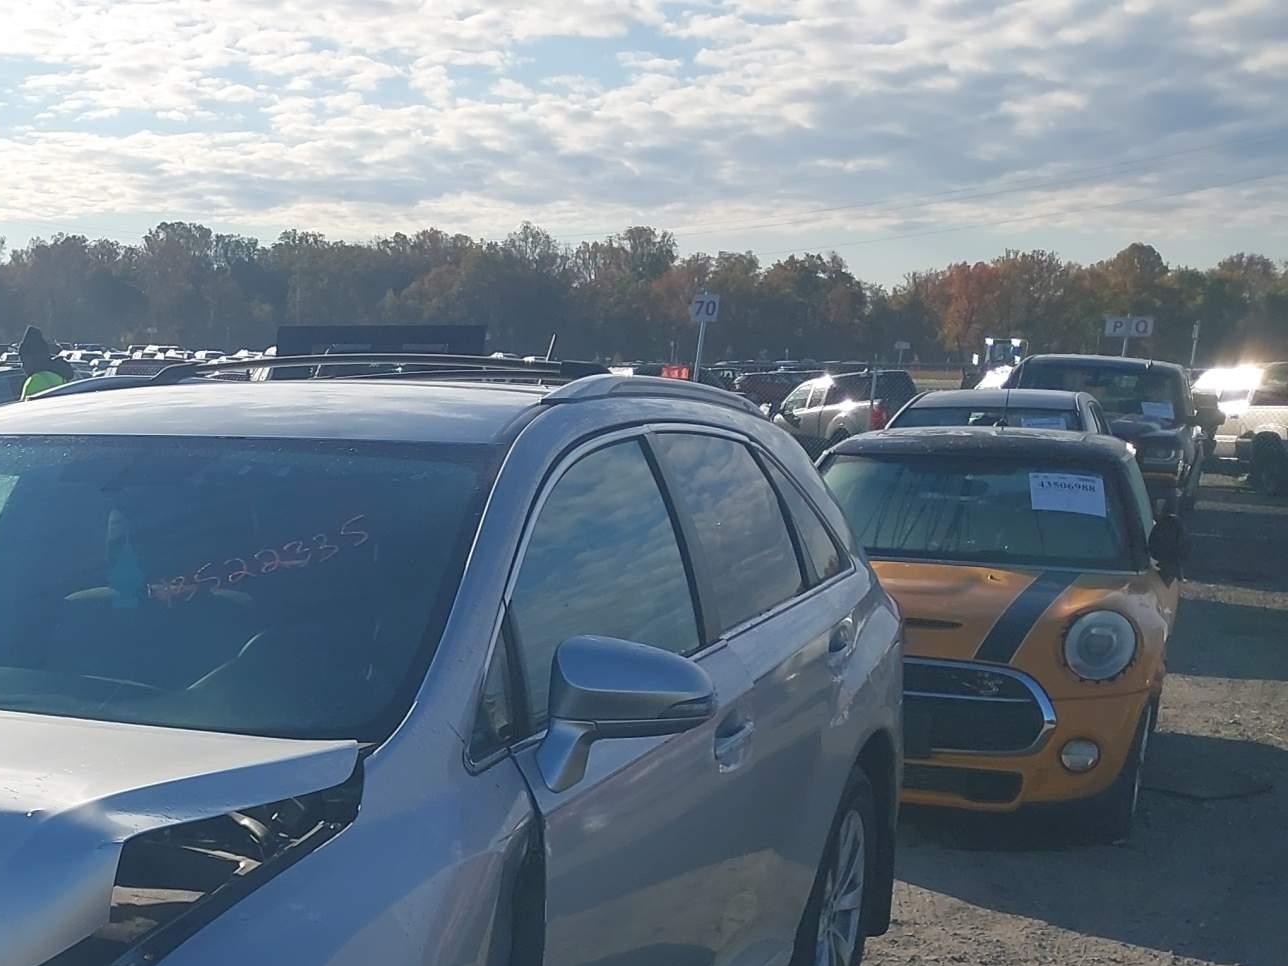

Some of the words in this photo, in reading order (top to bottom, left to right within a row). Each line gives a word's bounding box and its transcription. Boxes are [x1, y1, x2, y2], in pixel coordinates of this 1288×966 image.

[695, 300, 716, 316] 70
[1113, 320, 1123, 332] P
[1135, 319, 1148, 334] Q
